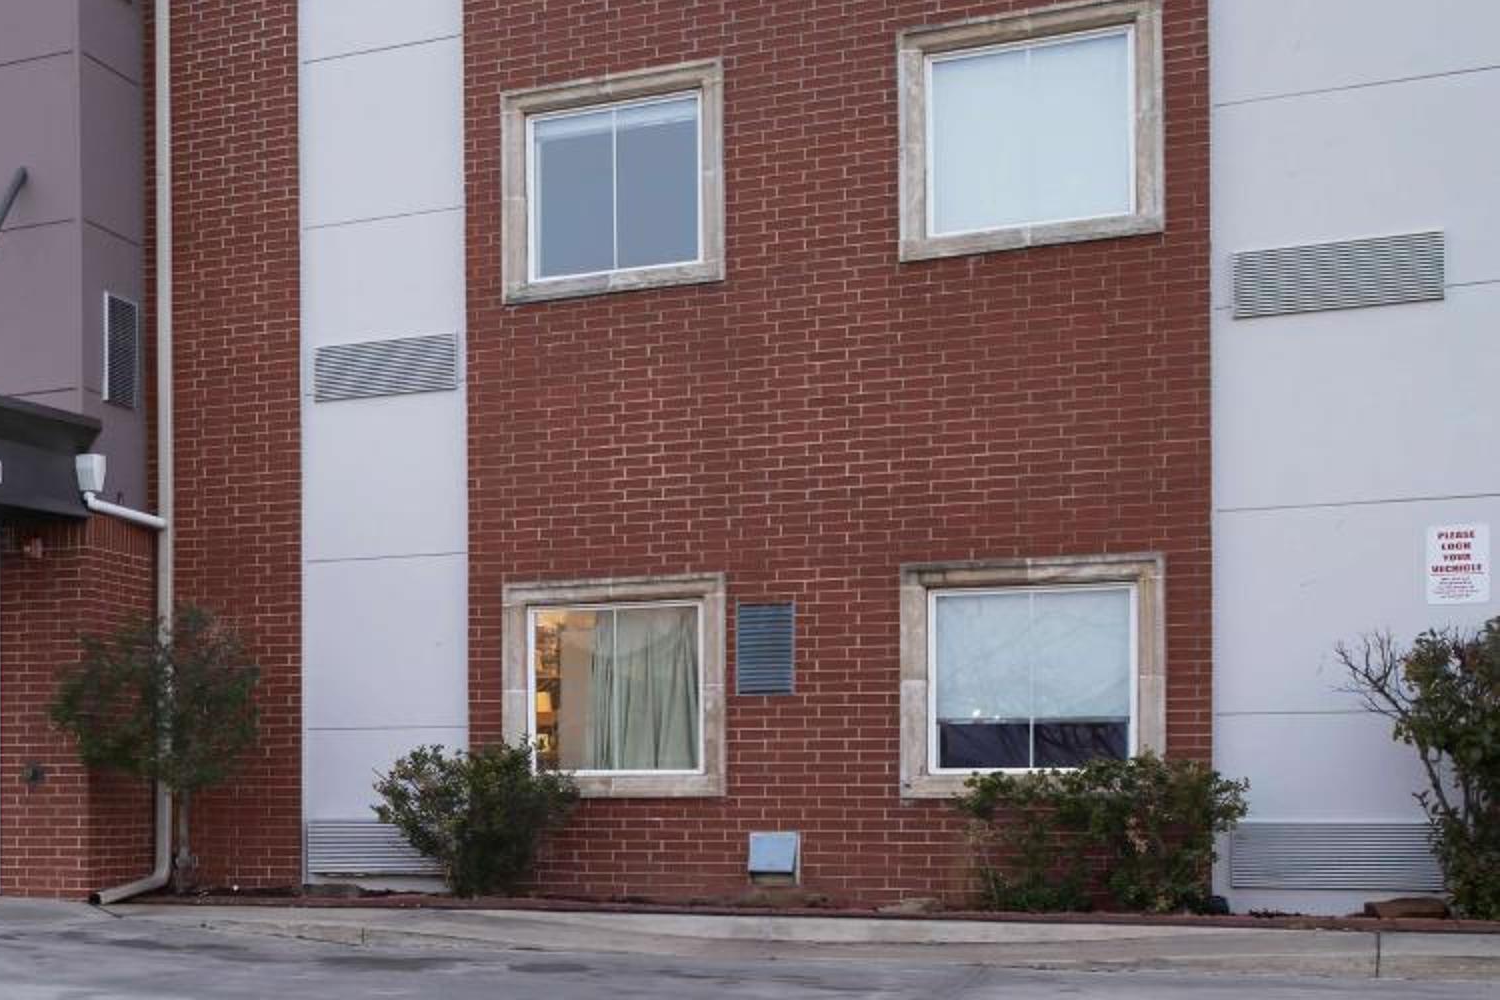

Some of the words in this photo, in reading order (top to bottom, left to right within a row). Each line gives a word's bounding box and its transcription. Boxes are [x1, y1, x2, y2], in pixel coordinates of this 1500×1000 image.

[1437, 530, 1475, 540] PLEASE
[1441, 542, 1472, 550] LOCK
[1443, 553, 1472, 562] YOUR
